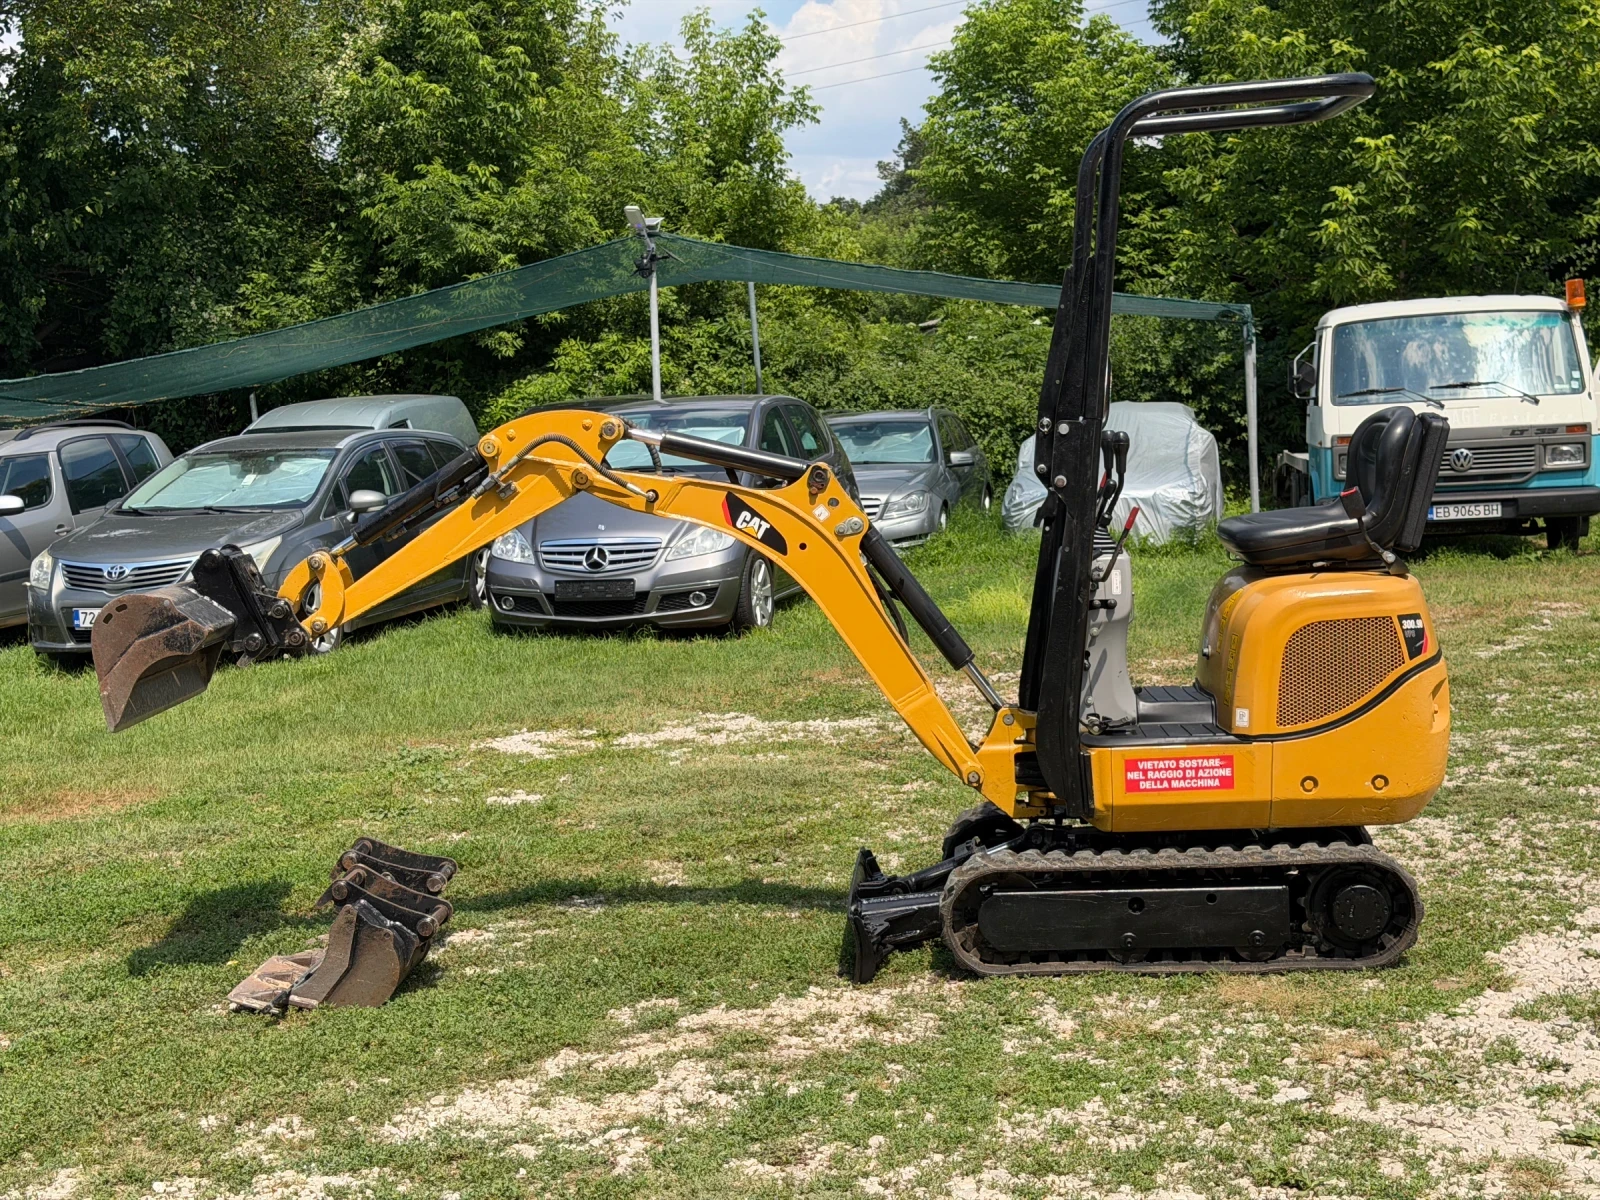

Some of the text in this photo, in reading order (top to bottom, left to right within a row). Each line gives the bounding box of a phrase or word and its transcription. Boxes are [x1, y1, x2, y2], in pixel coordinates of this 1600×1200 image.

[1509, 427, 1559, 436] LT 35
[1435, 506, 1450, 518] EB
[1453, 505, 1481, 517] 9065
[1483, 503, 1499, 516] BH
[735, 510, 771, 540] CAT
[1137, 758, 1221, 770] VIETATO SOSTARE
[1127, 767, 1232, 780] NEL RAGGIO DI AZIONE
[1139, 778, 1220, 789] DELLA MACCHINA
